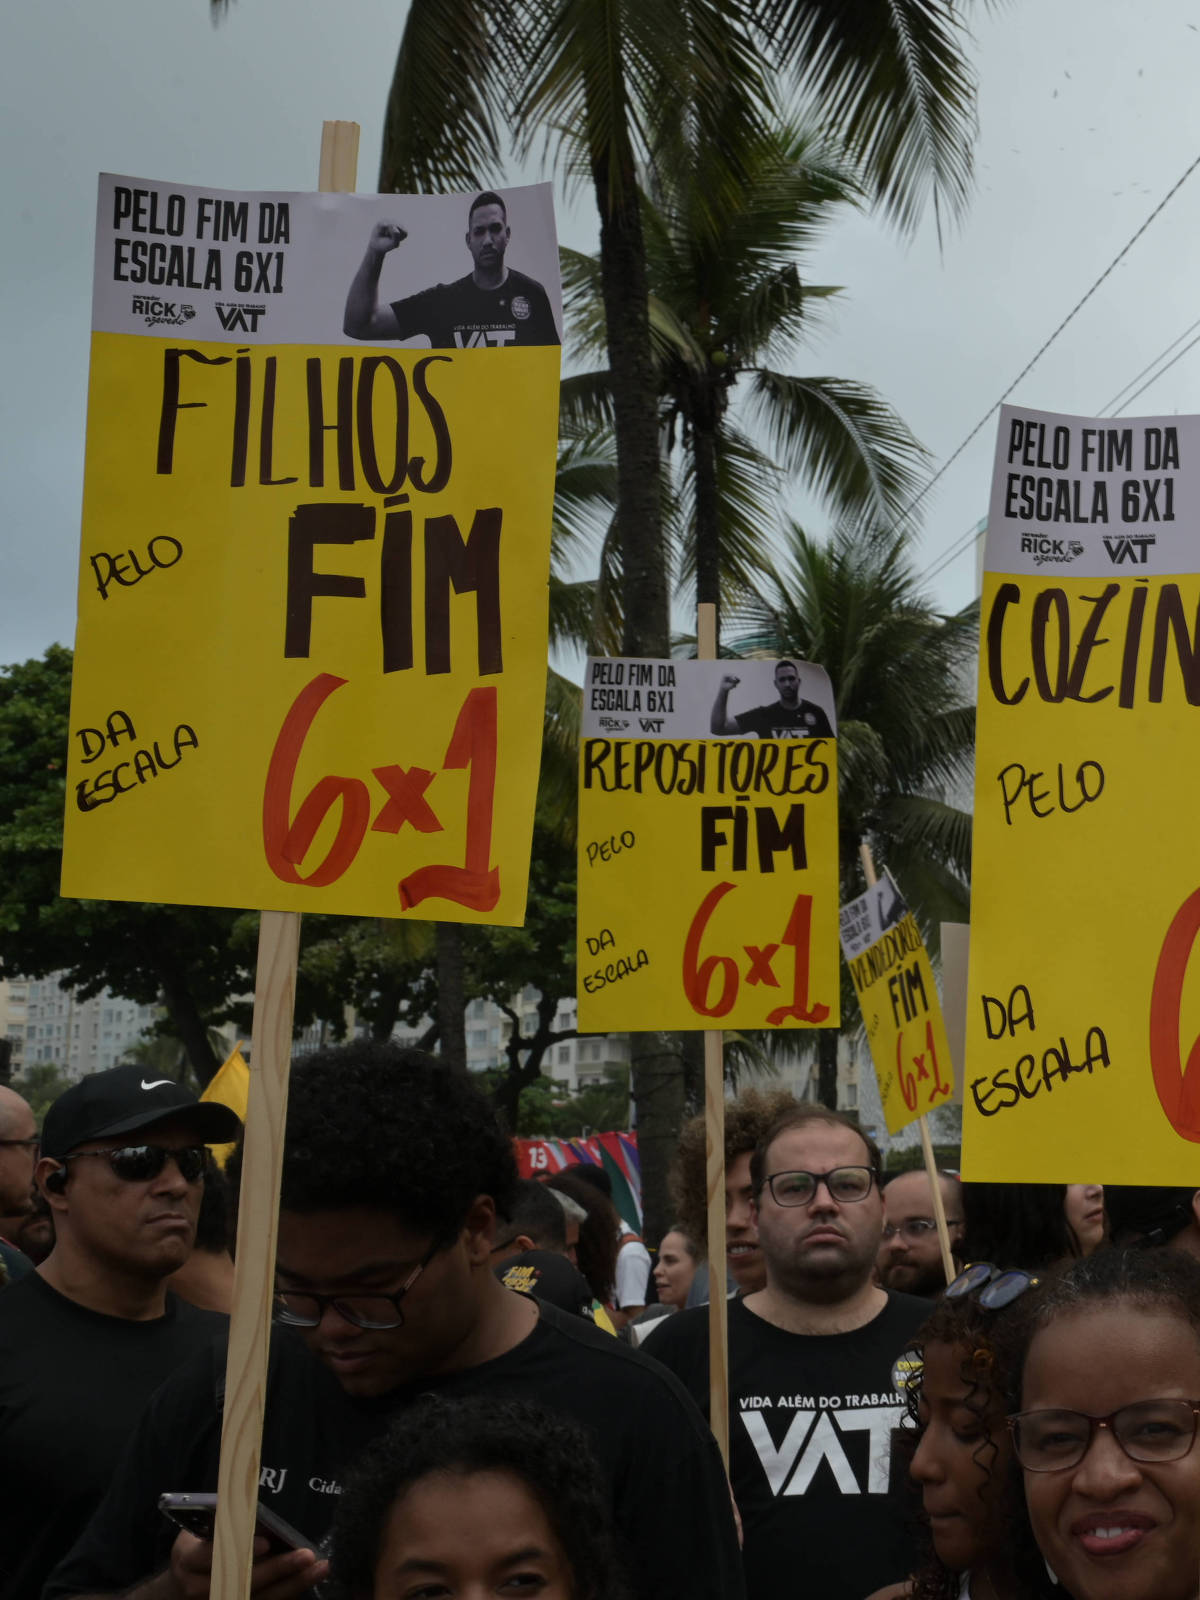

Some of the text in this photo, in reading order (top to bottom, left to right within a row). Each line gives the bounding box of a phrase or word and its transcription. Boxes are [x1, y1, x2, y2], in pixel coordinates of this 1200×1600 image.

[114, 186, 290, 244] PELO FIM DA
[114, 238, 284, 294] ESCALA 6X1
[132, 300, 176, 317] RICK
[215, 306, 266, 332] VAT
[156, 347, 454, 494] FILHOS
[1008, 418, 1180, 473] PELO FIM DA
[1004, 472, 1175, 524] ESCALA 6X1
[90, 535, 183, 600] PELO
[1021, 538, 1064, 554] RICK
[1103, 539, 1156, 564] VAT
[284, 493, 503, 676] FIM
[591, 688, 674, 713] ESCALA 6X1
[592, 662, 676, 687] PELO FIM DA
[76, 709, 137, 764] DA
[75, 723, 199, 812] ESCALA
[583, 738, 830, 797] REPOSITORES
[997, 760, 1105, 826] PELO
[585, 830, 635, 867] PELO
[700, 795, 808, 873] FIM
[585, 928, 616, 957] DA
[583, 949, 649, 994] ESCALA
[981, 985, 1036, 1040] DA
[970, 1026, 1110, 1118] ESCALA
[528, 1147, 548, 1168] 13
[739, 1392, 905, 1409] VIDA ALÉM DO TRABALH
[739, 1406, 918, 1496] VAT
[308, 1477, 343, 1495] Cida
